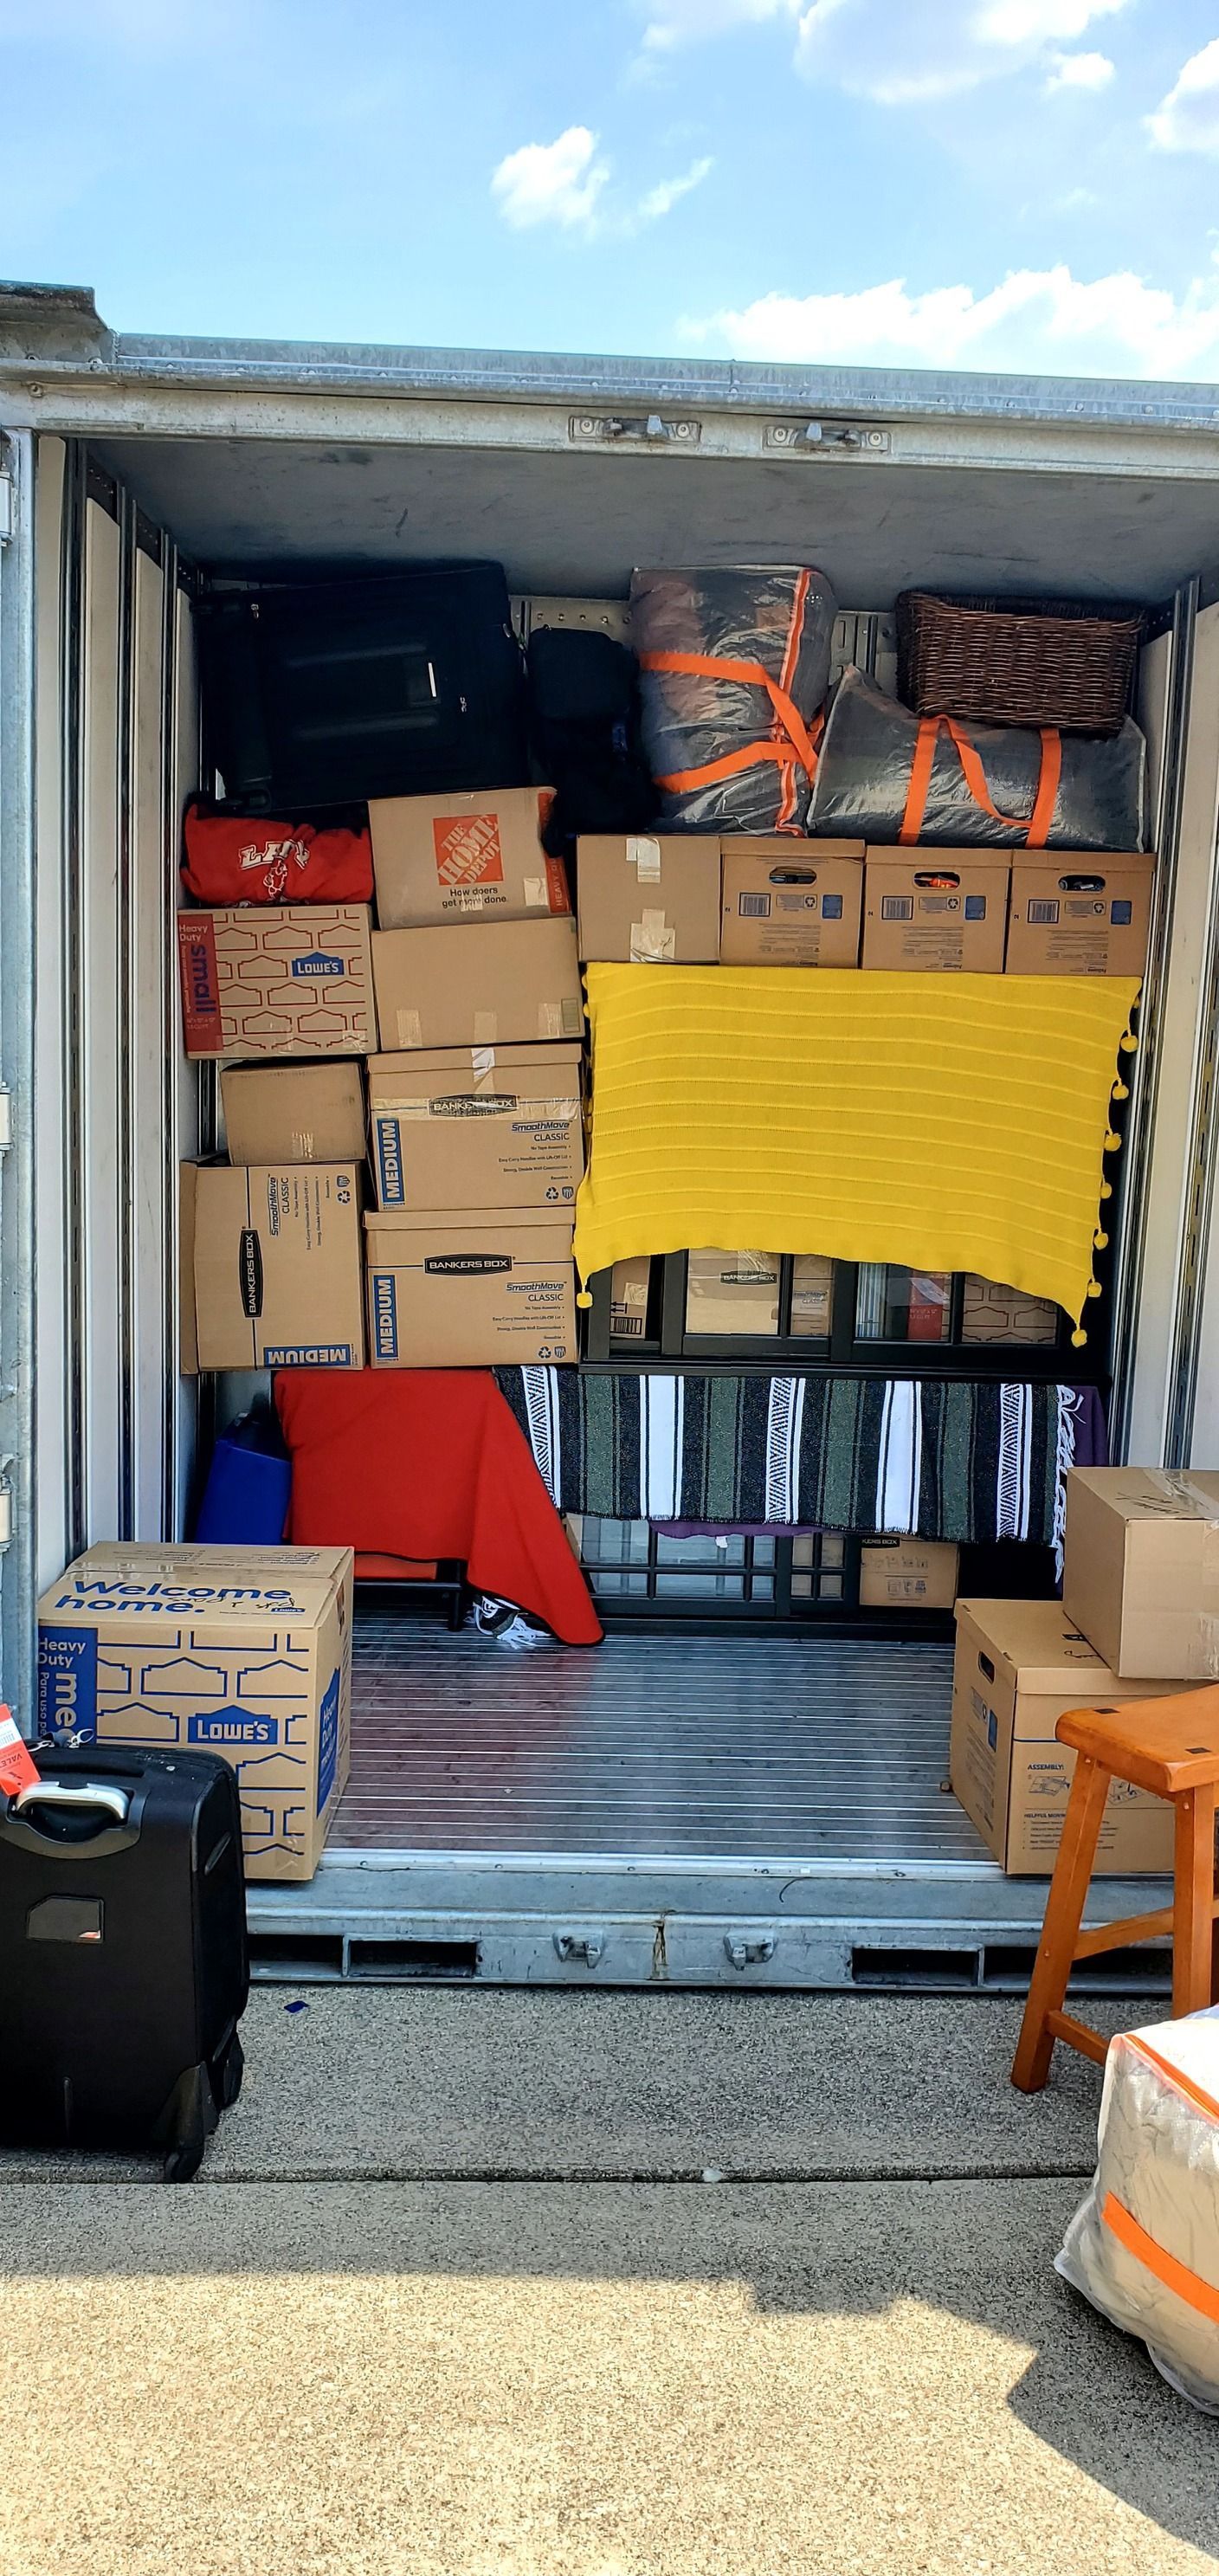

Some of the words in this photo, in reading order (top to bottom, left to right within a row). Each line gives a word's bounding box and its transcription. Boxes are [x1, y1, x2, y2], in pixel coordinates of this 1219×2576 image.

[441, 823, 465, 851] THE
[438, 816, 498, 884] HOME
[464, 838, 500, 883] DEPOT
[450, 888, 470, 897] How
[473, 887, 499, 895] doers
[442, 899, 457, 909] get
[179, 925, 208, 933] Heavy
[180, 933, 202, 942] Duty
[297, 961, 339, 974] LOWE'S
[190, 944, 216, 1012] small
[512, 1121, 570, 1133] SmoothMove
[533, 1133, 570, 1142] CLASSIC
[382, 1121, 401, 1198] MEDIUM
[281, 1177, 290, 1214] CLASSIC
[268, 1177, 279, 1236] SmoothMove
[245, 1233, 255, 1258] BOX
[429, 1261, 483, 1269] BANKERS
[246, 1259, 256, 1314] BANKERS
[506, 1282, 564, 1291] SmoothMove
[528, 1293, 564, 1302] CLASSIC
[377, 1279, 394, 1354] MEDIUM
[268, 1348, 346, 1365] MEDIUM
[75, 1581, 291, 1599] Welcome
[55, 1595, 205, 1613] home.
[40, 1671, 50, 1698] Para
[197, 1720, 269, 1741] LOWE'S
[0, 1752, 23, 1768] VALE
